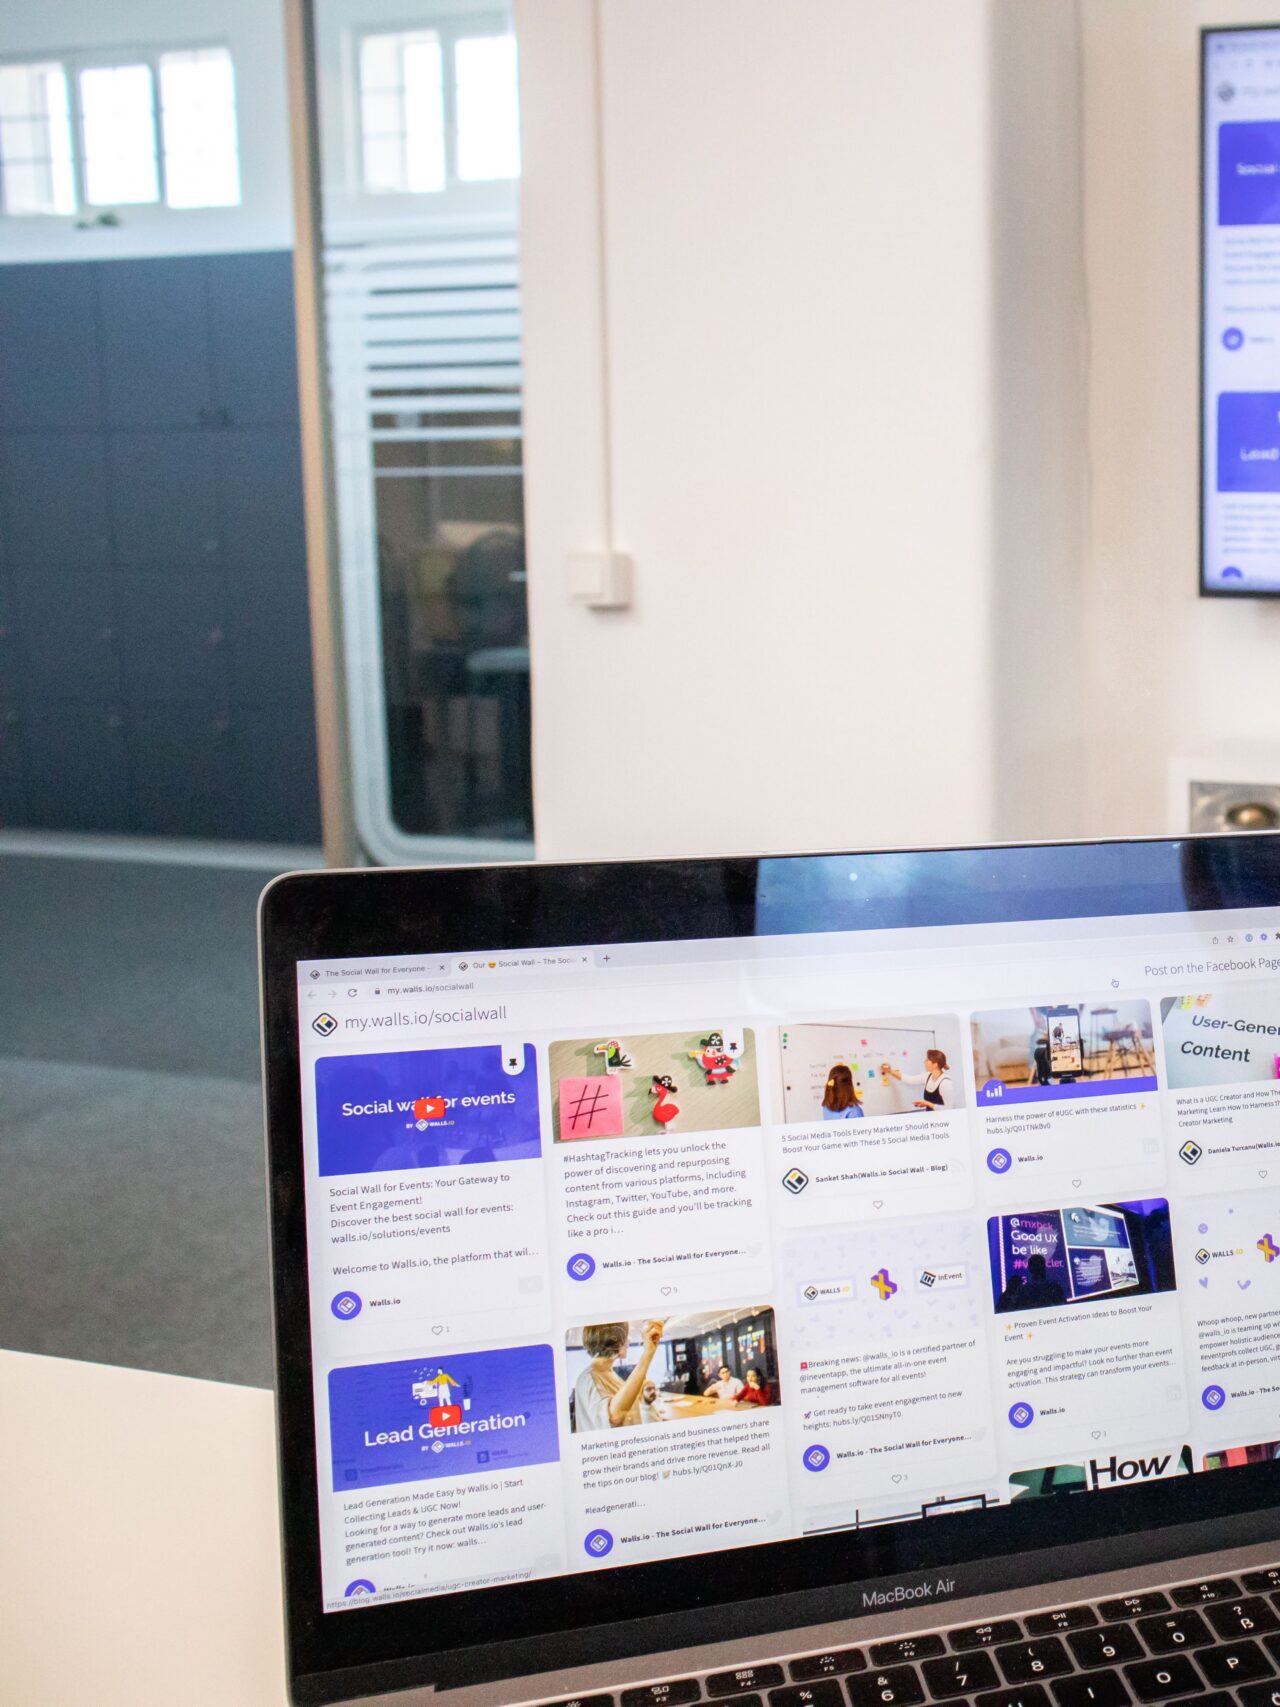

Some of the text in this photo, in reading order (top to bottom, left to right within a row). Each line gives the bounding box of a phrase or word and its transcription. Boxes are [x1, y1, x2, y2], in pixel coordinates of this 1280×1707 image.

[341, 968, 362, 977] Social
[381, 967, 391, 976] for
[498, 960, 519, 968] Social
[1145, 966, 1167, 976] Post
[1170, 966, 1183, 975] on
[1187, 962, 1203, 973] the
[1207, 958, 1256, 972] Facebook
[387, 982, 474, 996] my.walls.io/socialwall
[345, 1005, 507, 1032] my.walls.io/socialwall
[1181, 1040, 1251, 1062] Content
[342, 1099, 393, 1116] Social
[461, 1092, 516, 1107] events
[563, 1141, 727, 1163] #HashtagTracking lets you unlock the
[564, 1156, 730, 1180] power of discovering and repurposing
[888, 1168, 908, 1176] Social
[930, 1164, 948, 1172] Blog)
[329, 1186, 358, 1197] Social
[361, 1184, 381, 1194] Wall
[384, 1183, 397, 1192] for
[400, 1181, 432, 1191] Events:
[435, 1179, 456, 1188] Your
[458, 1176, 498, 1186] Gateway
[565, 1169, 747, 1194] content from various platforms, including
[330, 1196, 423, 1213] Event Engagement!
[566, 1186, 736, 1208] Instagram, Twitter, YouTube, and more.
[331, 1204, 514, 1228] Discover the best social wall for events:
[566, 1198, 752, 1223] Check out this guide and you'll be tracking
[331, 1225, 451, 1244] walls.io/solutions/events
[568, 1229, 584, 1238] like
[594, 1228, 609, 1238] pro
[1011, 1230, 1058, 1243] Good UX
[1012, 1244, 1048, 1255] be like
[332, 1264, 377, 1275] Welcome
[392, 1258, 431, 1270] Walls.io,
[433, 1256, 449, 1265] the
[451, 1252, 491, 1266] platform
[494, 1250, 513, 1260] that
[369, 1298, 401, 1307] Walls.io
[364, 1414, 526, 1447] Lead Generation
[1090, 1455, 1172, 1487] How
[344, 1479, 523, 1511] Lead Generation Made Easy by Walls.io Start
[344, 1512, 386, 1524] Collecting
[388, 1508, 411, 1518] Leads
[421, 1504, 438, 1513] UGC
[440, 1500, 461, 1511] Now!
[862, 1579, 955, 1608] MacBook Air
[1103, 1646, 1116, 1657] 9
[1031, 1661, 1044, 1672] 8
[1226, 1658, 1239, 1669] P
[956, 1674, 967, 1686] 7
[881, 1690, 894, 1701] 6
